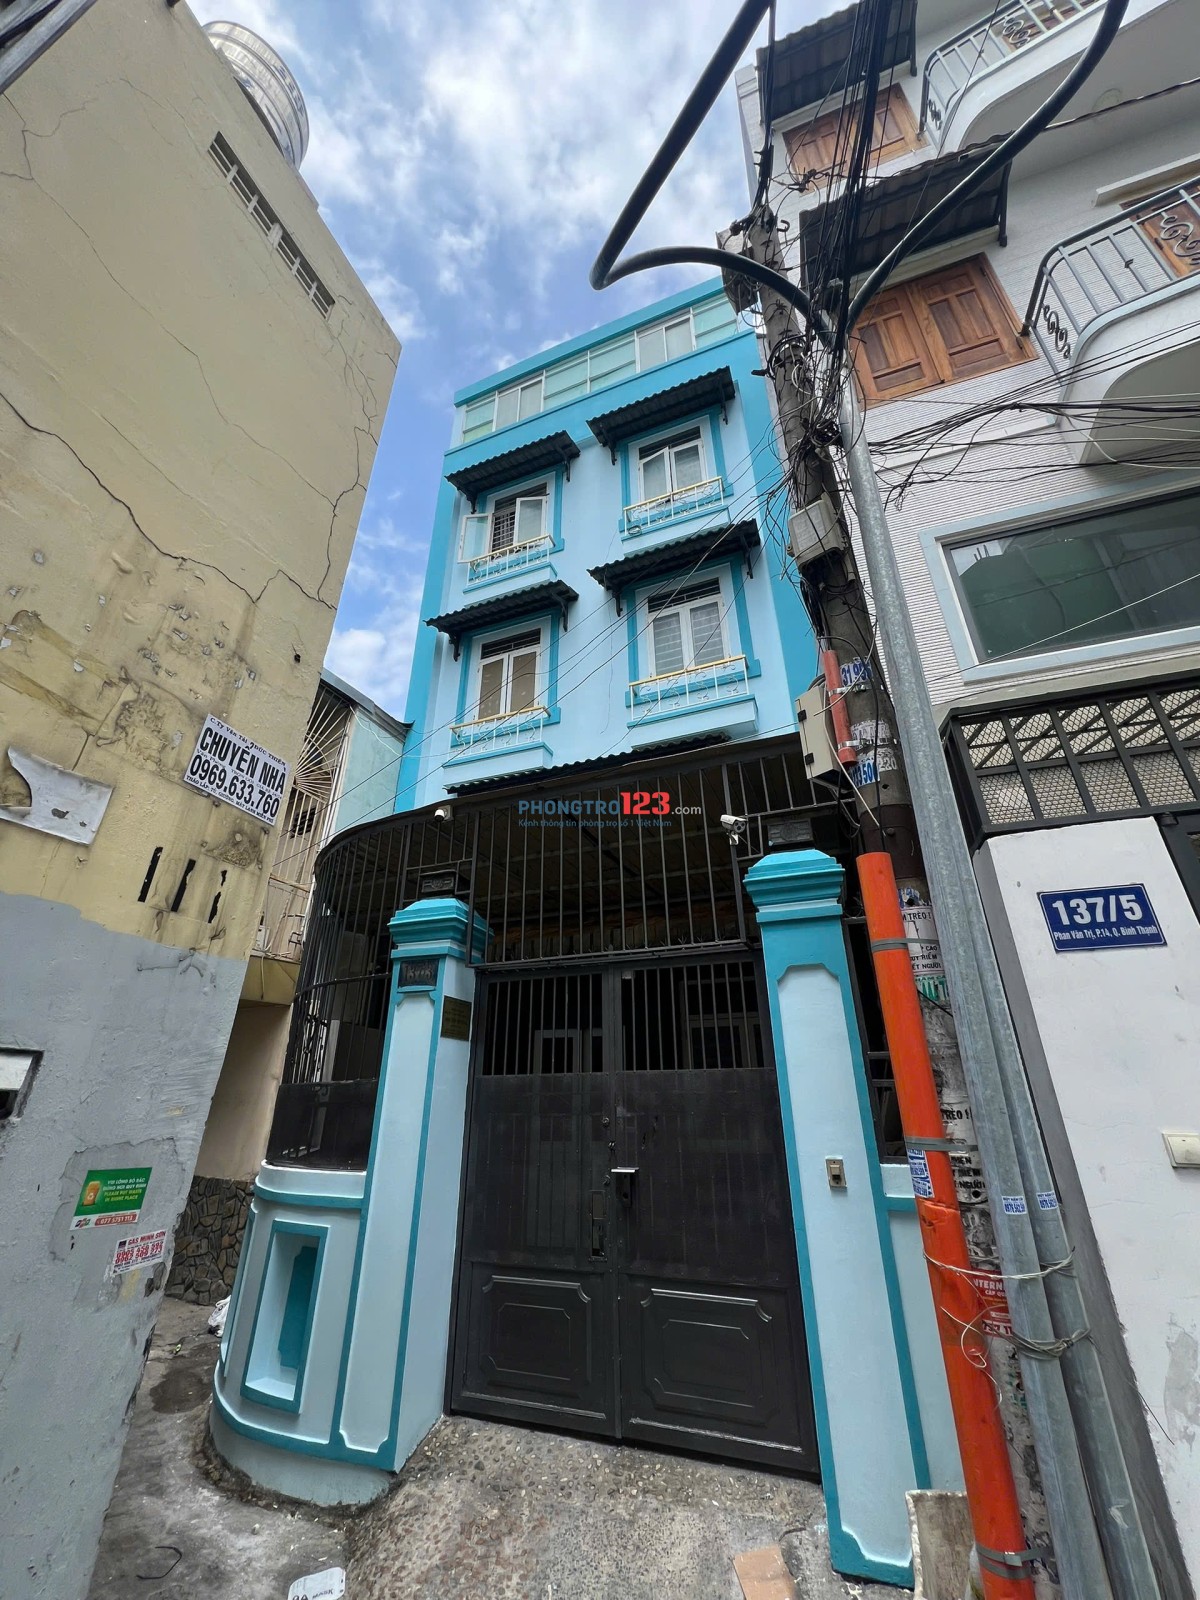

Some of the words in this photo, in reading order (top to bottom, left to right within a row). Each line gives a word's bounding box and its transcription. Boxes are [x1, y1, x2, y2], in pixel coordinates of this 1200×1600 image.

[200, 727, 259, 779] CHUYỂN
[258, 761, 286, 795] NHÀ
[189, 754, 280, 818] 0969.633.760
[1052, 894, 1143, 925] 137/5
[1053, 931, 1071, 941] Phan
[1070, 929, 1085, 940] Văn
[974, 1279, 1003, 1290] NTERN
